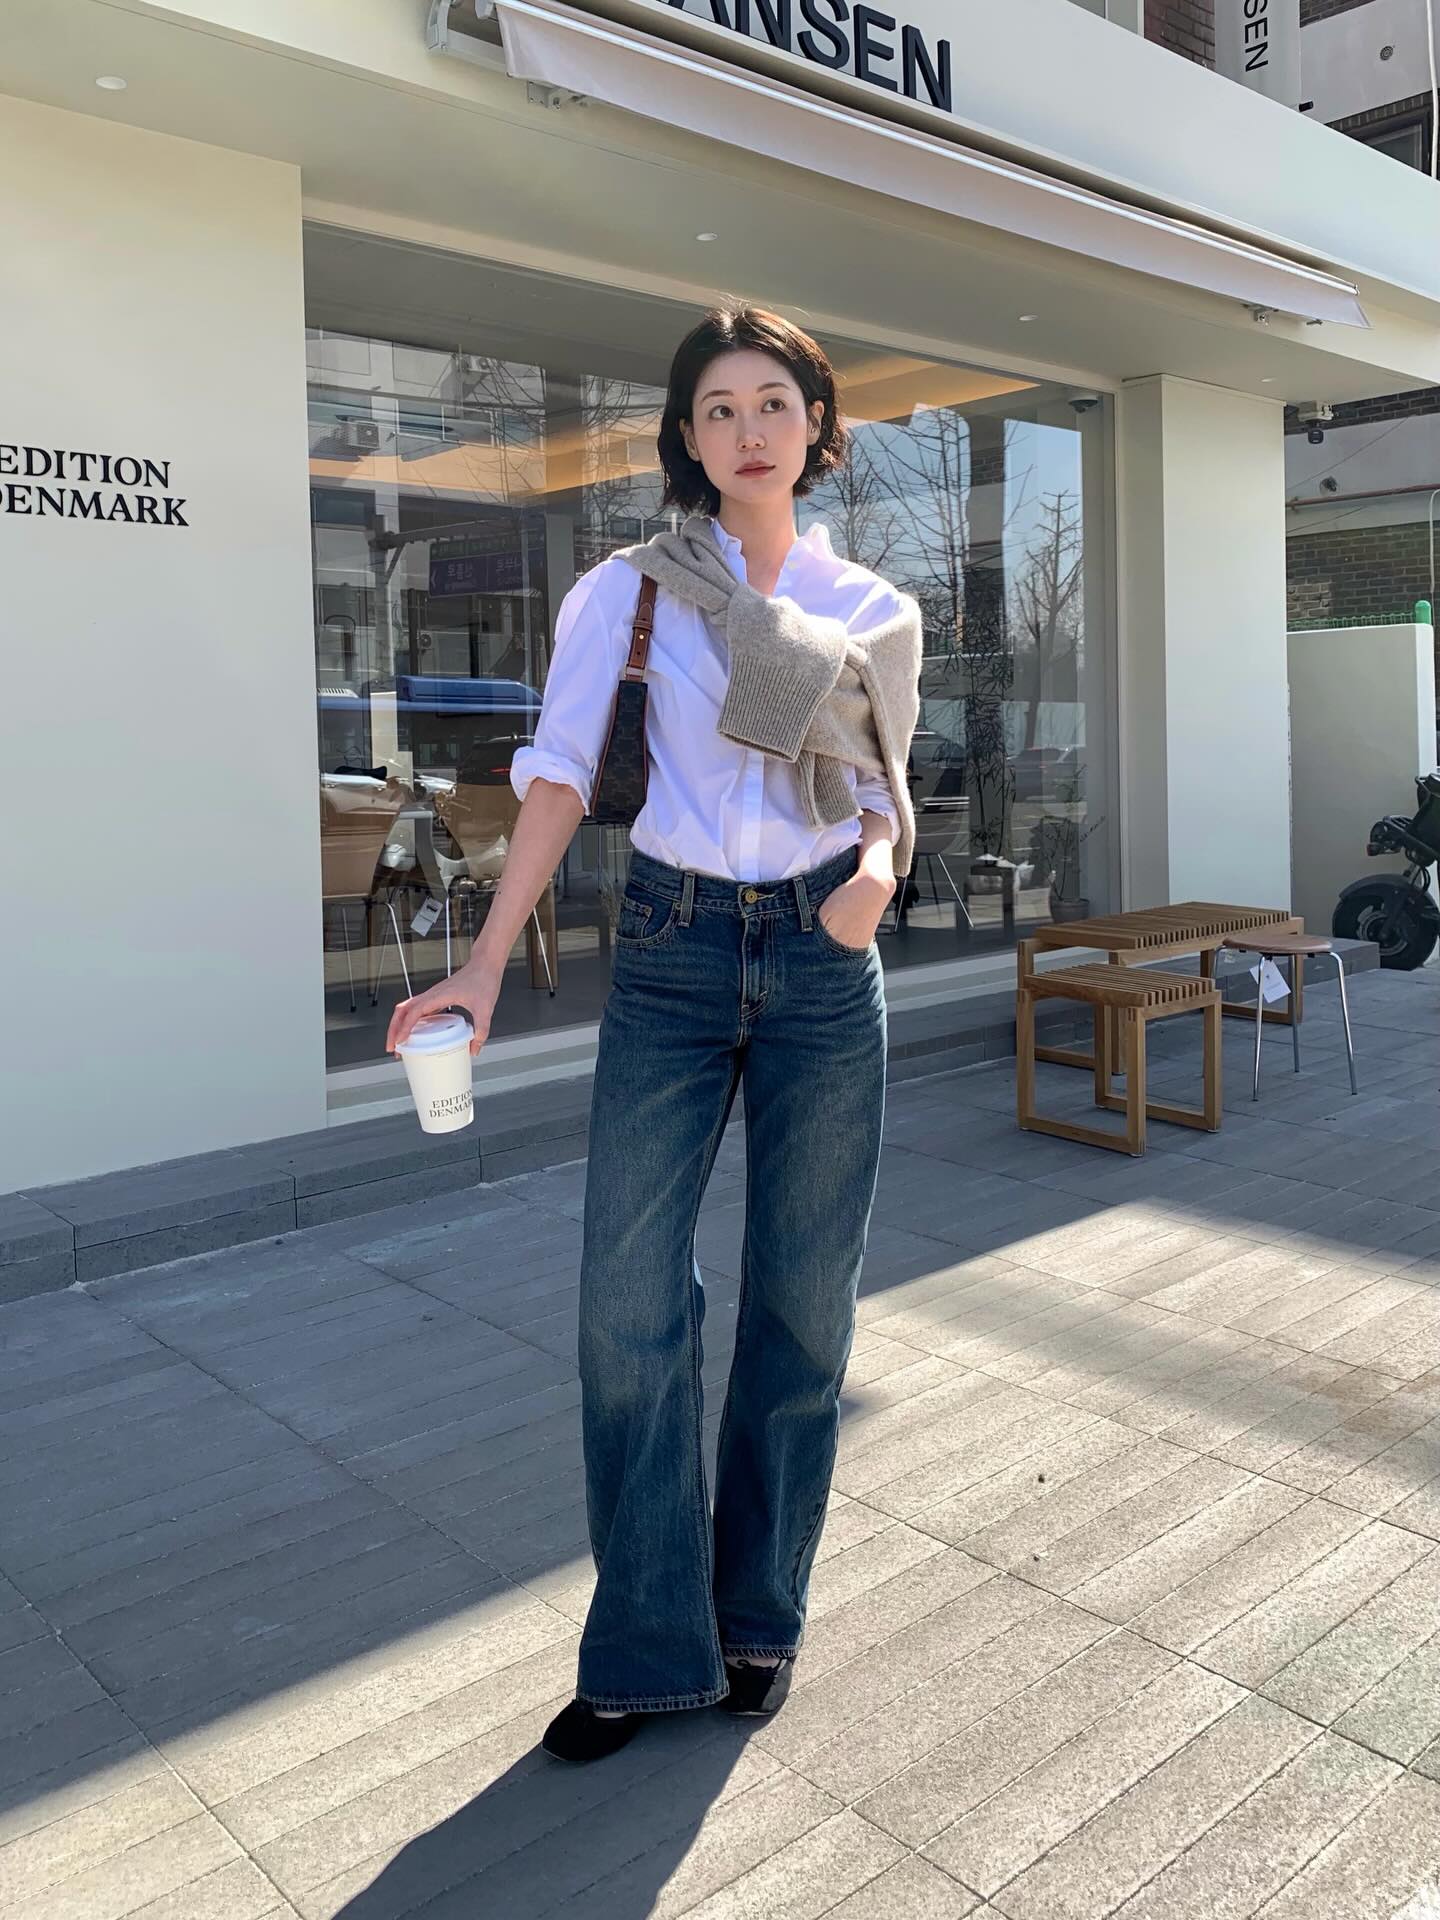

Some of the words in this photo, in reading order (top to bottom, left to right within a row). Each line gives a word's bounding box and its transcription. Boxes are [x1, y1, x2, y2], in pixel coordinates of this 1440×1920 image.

[1244, 0, 1268, 72] SEN
[0, 444, 171, 488] EDITION
[0, 484, 189, 526] ENMARK
